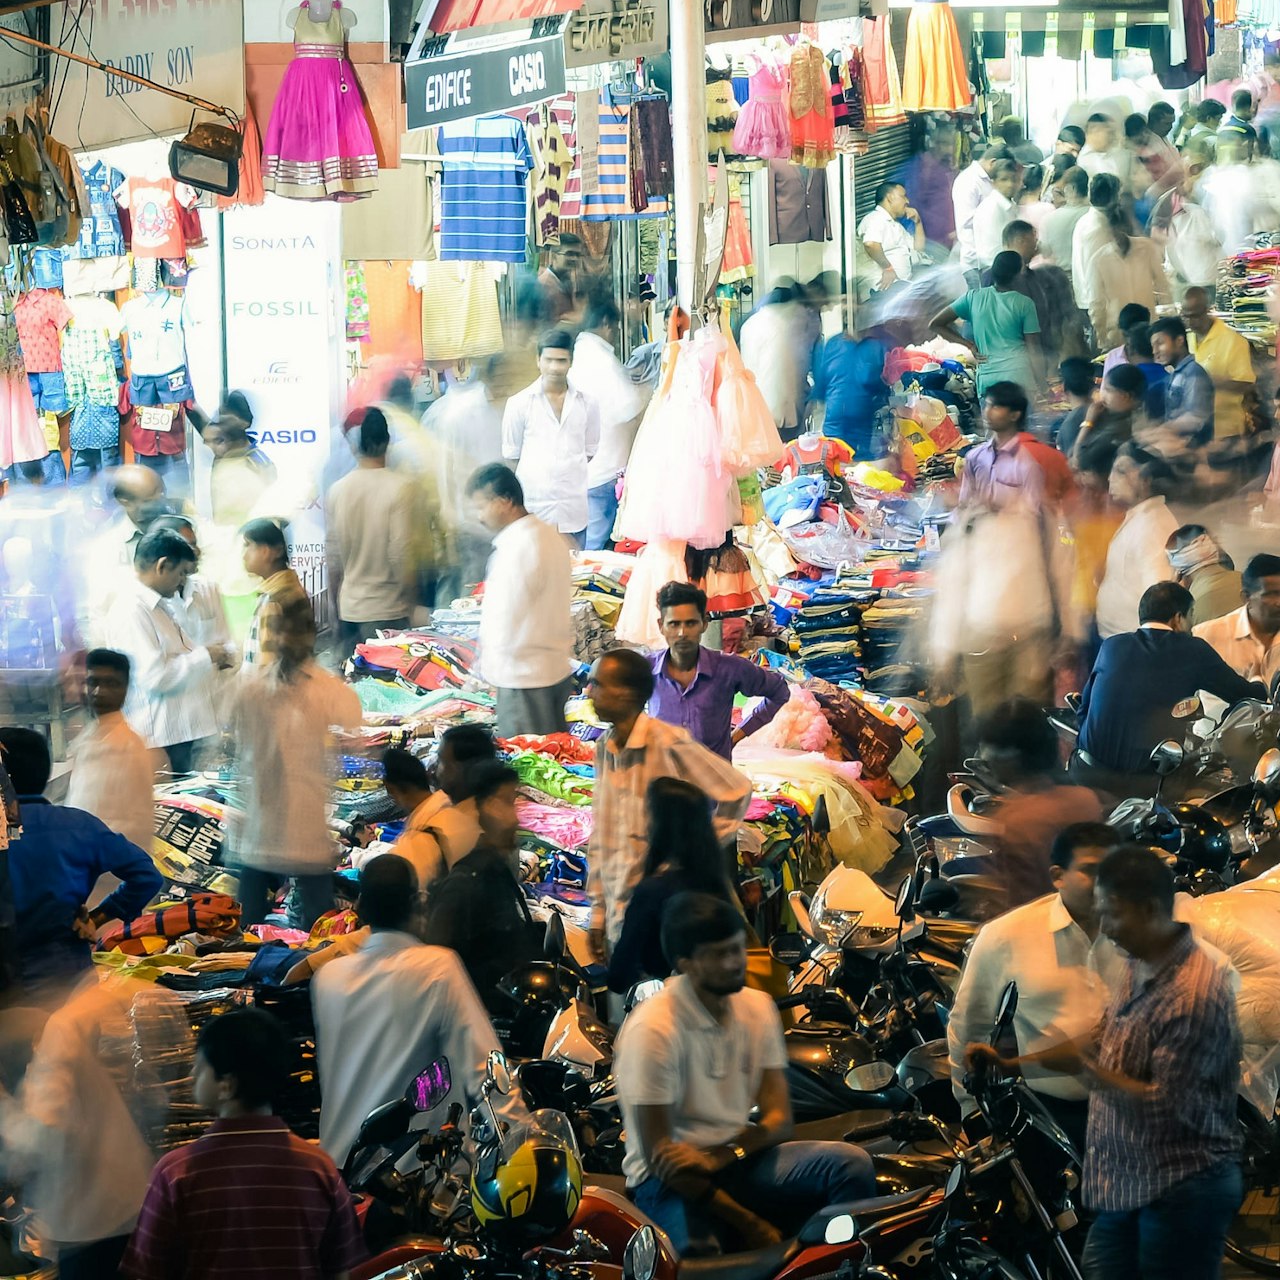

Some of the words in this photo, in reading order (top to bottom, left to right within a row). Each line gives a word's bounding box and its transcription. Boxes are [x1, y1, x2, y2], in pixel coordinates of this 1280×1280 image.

[167, 45, 194, 87] SON
[508, 51, 546, 97] CASIO
[425, 68, 472, 113] EDIFICE
[231, 235, 316, 250] SONATA
[232, 301, 319, 317] FOSSIL
[143, 411, 171, 428] 350
